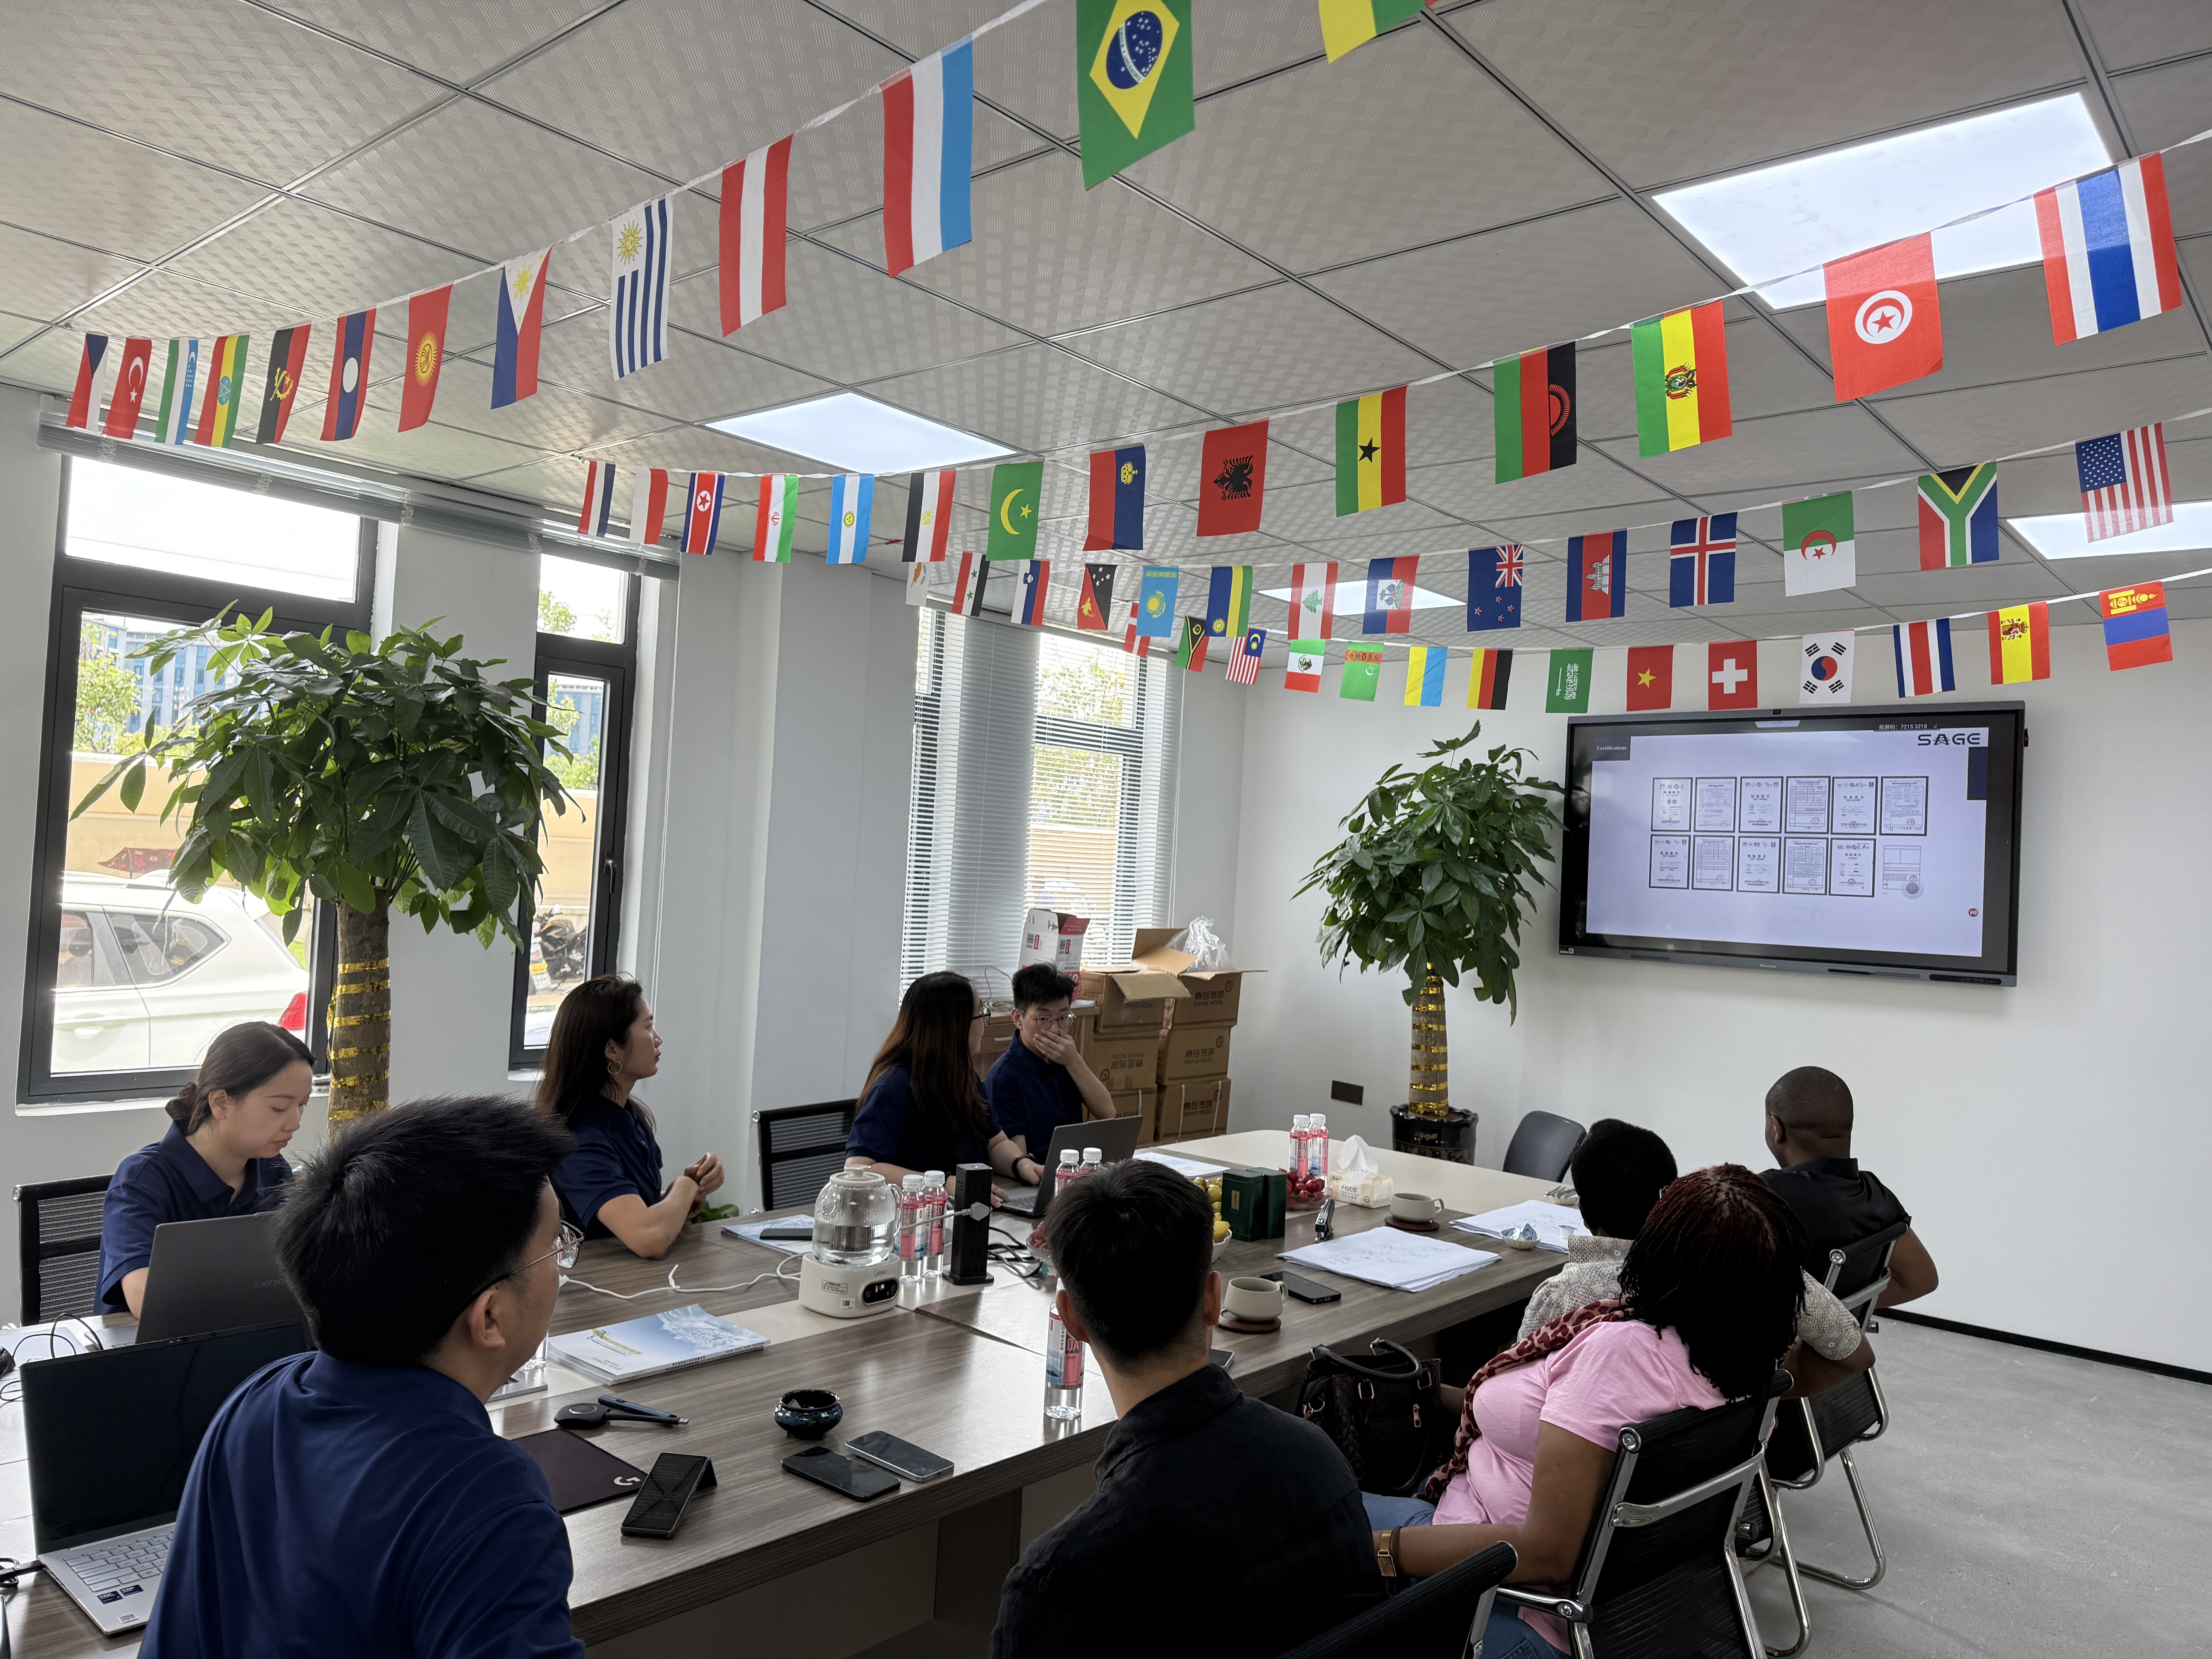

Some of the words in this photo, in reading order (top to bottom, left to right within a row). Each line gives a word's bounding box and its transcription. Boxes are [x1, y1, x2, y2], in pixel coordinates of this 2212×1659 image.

[1918, 733, 1980, 745] SAGE
[1341, 1184, 1357, 1193] Face
[1066, 1338, 1079, 1351] DA
